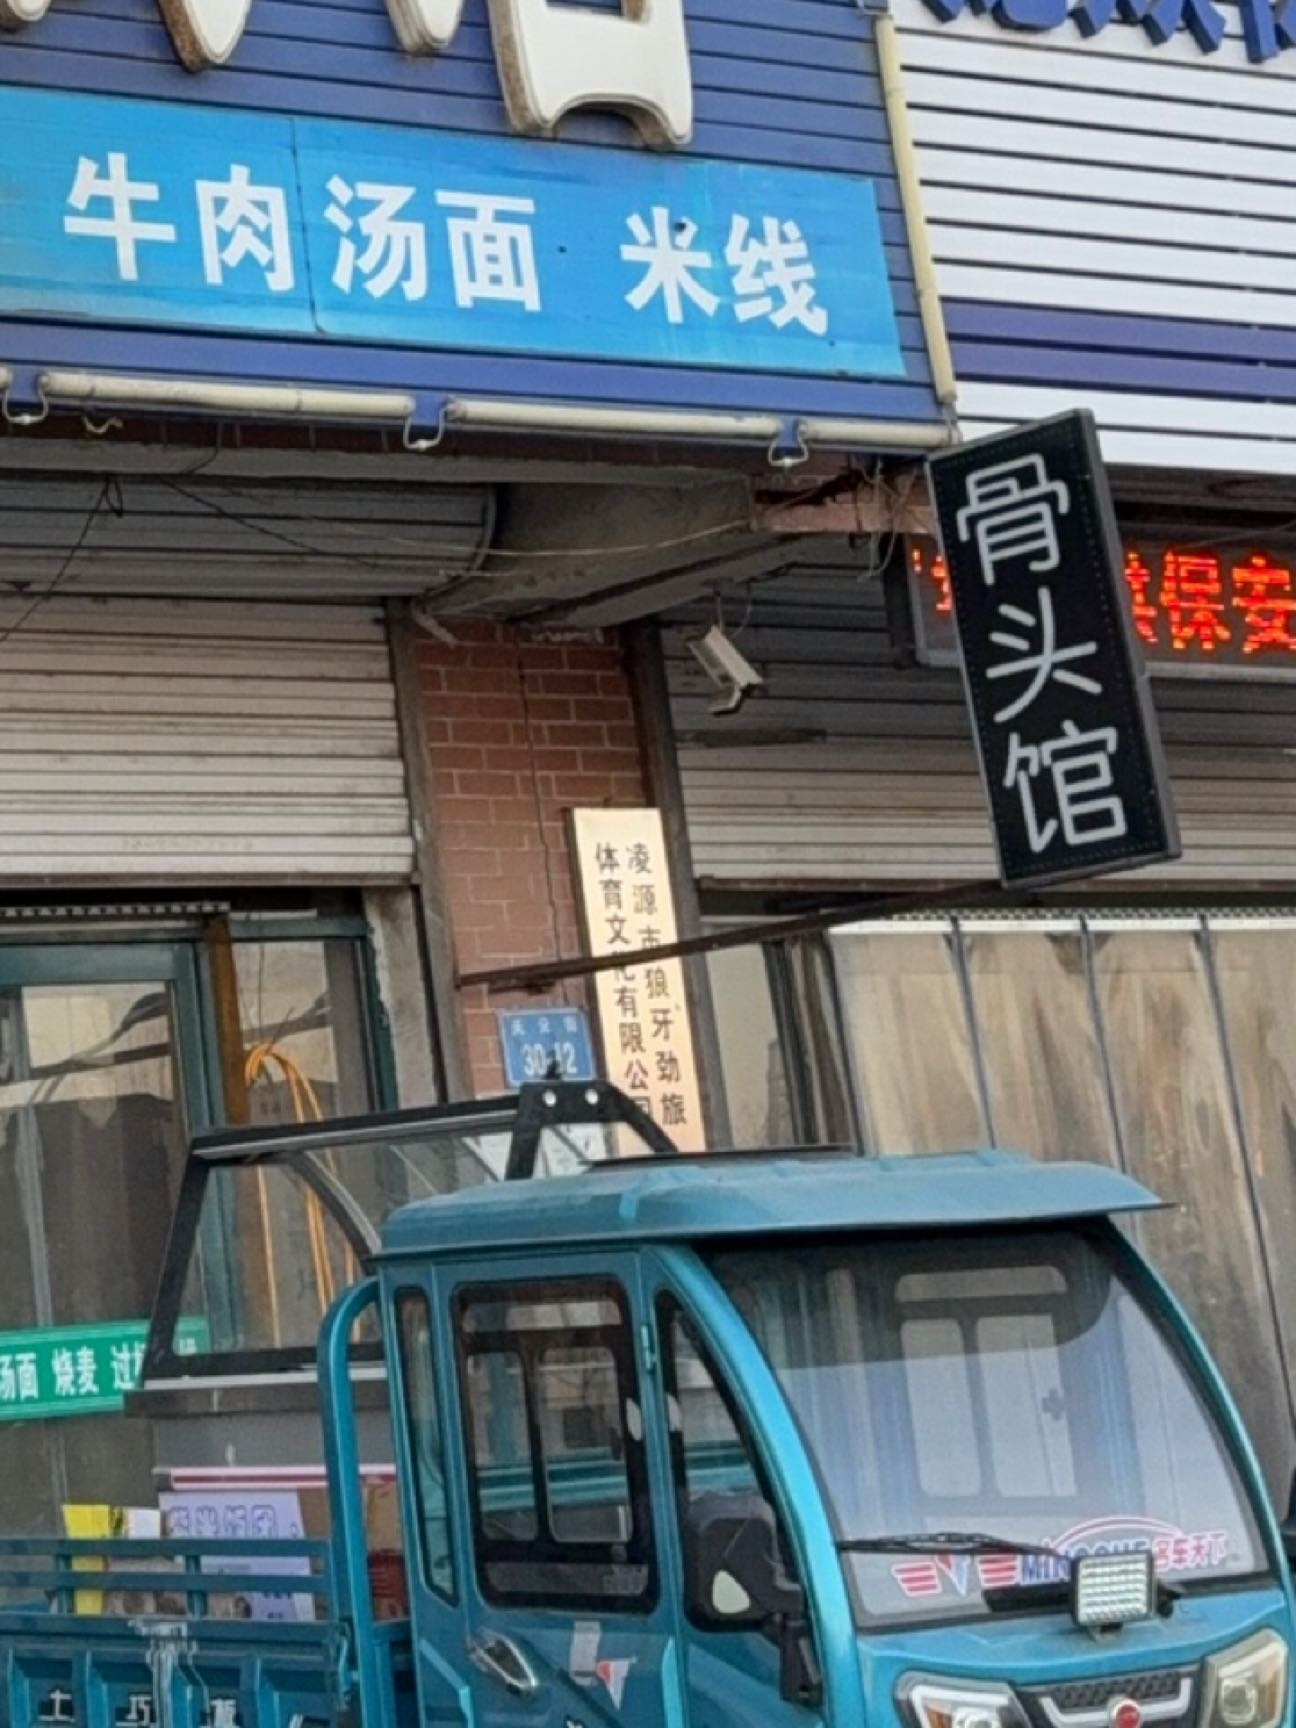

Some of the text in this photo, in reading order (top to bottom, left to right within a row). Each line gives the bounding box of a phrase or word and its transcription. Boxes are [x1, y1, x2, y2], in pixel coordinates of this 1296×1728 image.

[64, 151, 541, 313] 牛肉汤面
[620, 205, 830, 337] 米线
[956, 453, 1127, 854] 骨头馆
